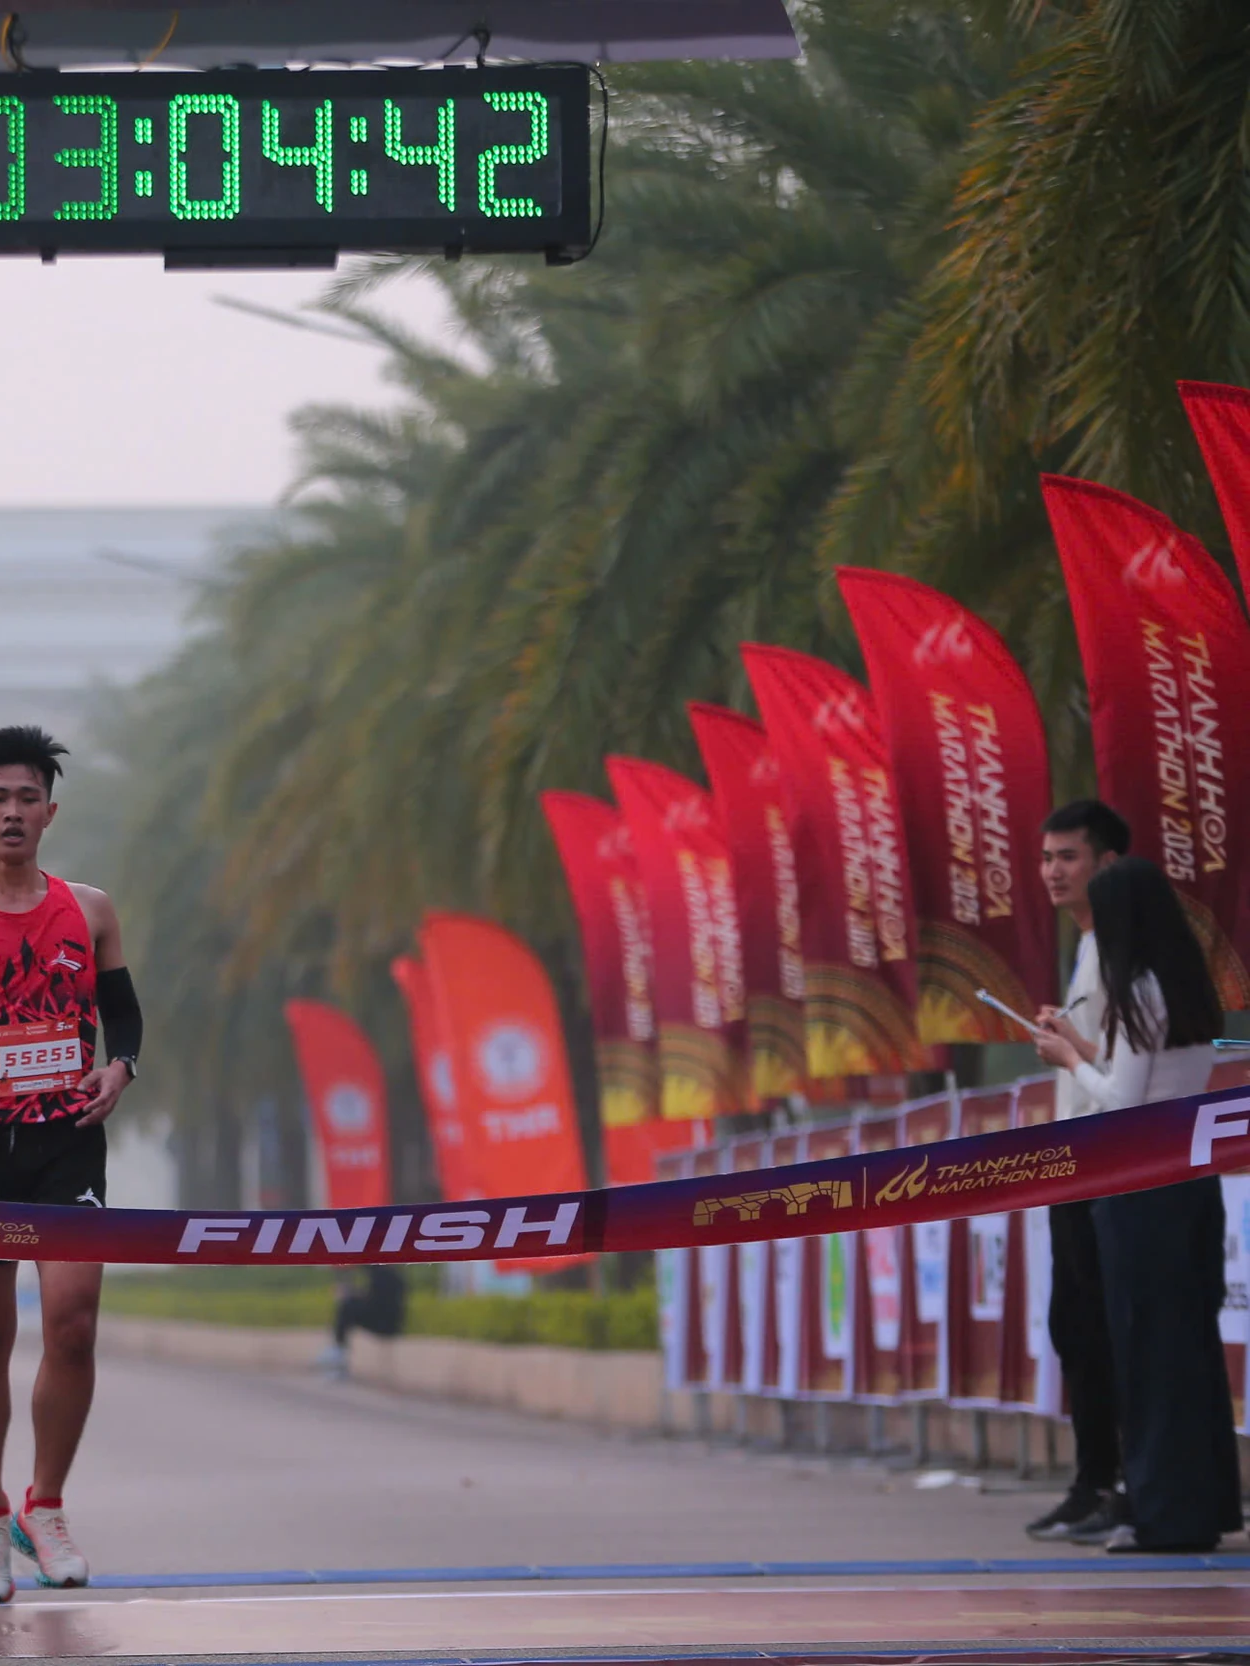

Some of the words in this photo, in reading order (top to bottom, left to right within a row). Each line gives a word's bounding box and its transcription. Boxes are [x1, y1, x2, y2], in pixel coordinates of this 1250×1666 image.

[1139, 617, 1190, 813] MARATHON
[927, 689, 975, 865] MARATHON
[1160, 814, 1196, 882] 2025
[949, 862, 981, 927] 2025
[5, 1045, 76, 1067] 55255
[928, 1167, 1039, 1196] MARATHON
[1039, 1160, 1078, 1180] 2025
[2, 1233, 41, 1245] 2025
[176, 1202, 581, 1253] FINISH
